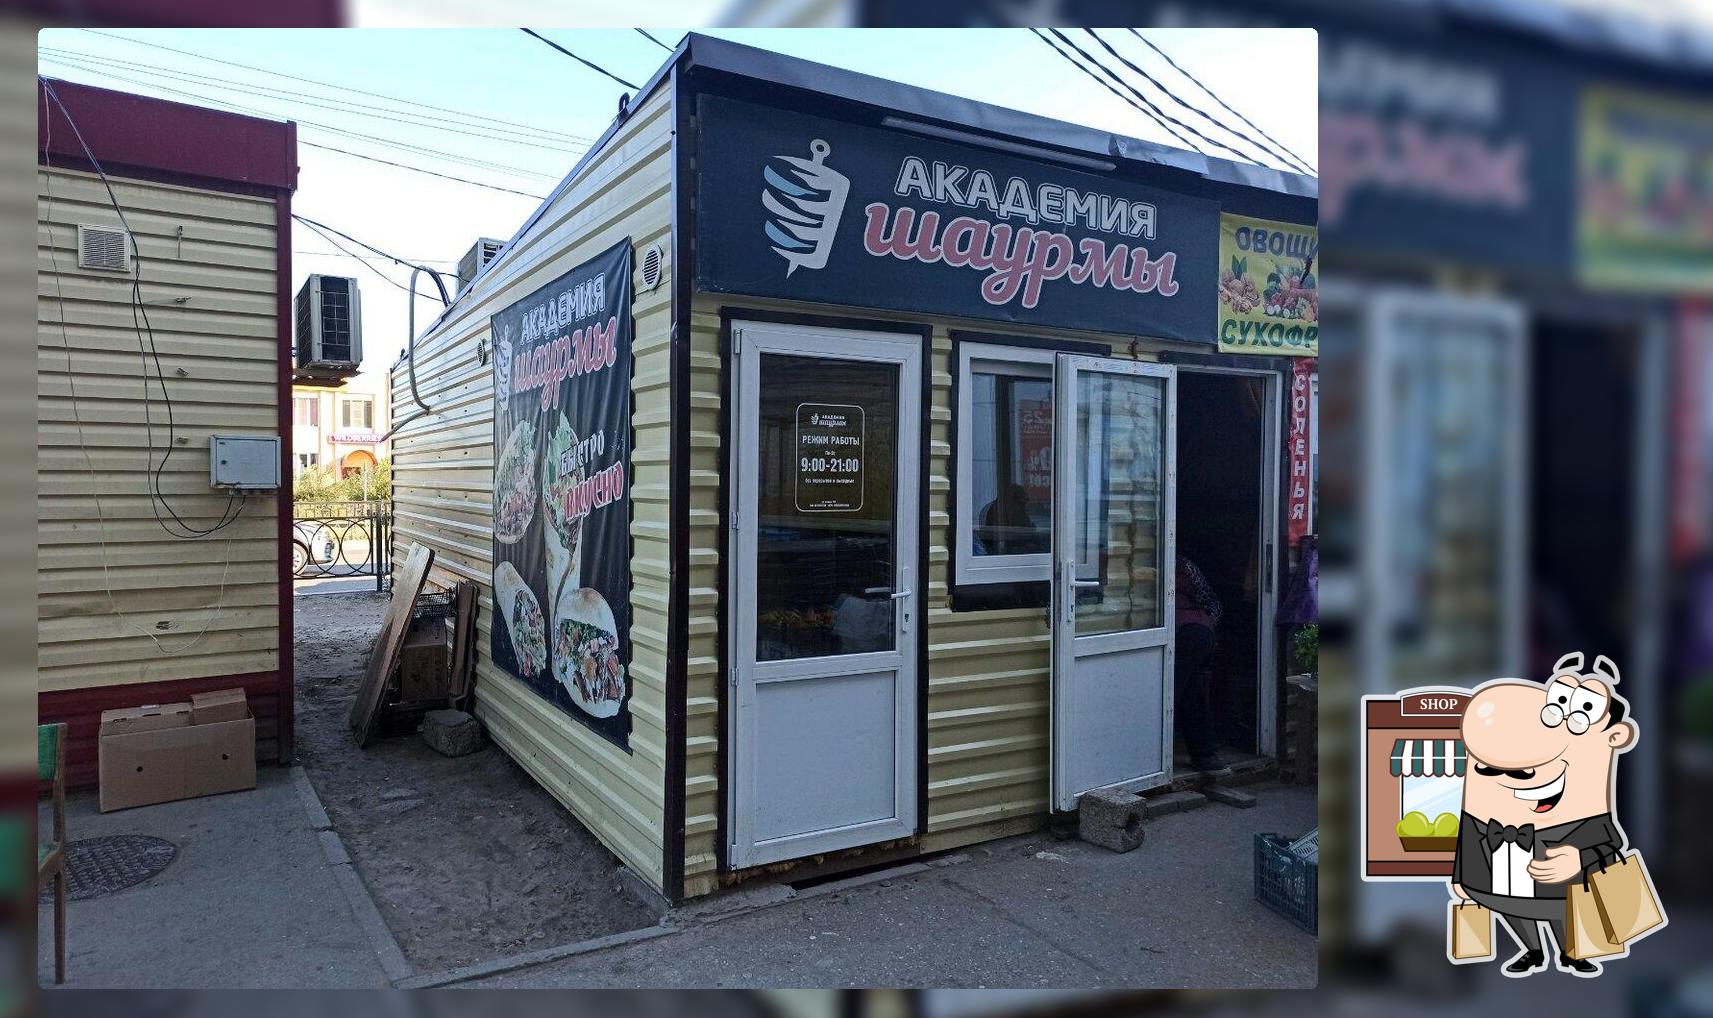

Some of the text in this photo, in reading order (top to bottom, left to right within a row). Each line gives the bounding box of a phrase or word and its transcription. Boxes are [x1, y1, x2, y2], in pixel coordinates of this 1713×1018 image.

[894, 156, 1157, 239] АКАДЕМИЯ
[863, 202, 1179, 308] шаурмы
[521, 272, 606, 346] АКАДЕМИЯ
[514, 316, 618, 412] шаурмы
[801, 457, 859, 472] 9:00-21:00
[802, 435, 860, 446] РЕЖИМ РАБОТЫ
[1292, 374, 1307, 520] СОЛЕНЬЯ
